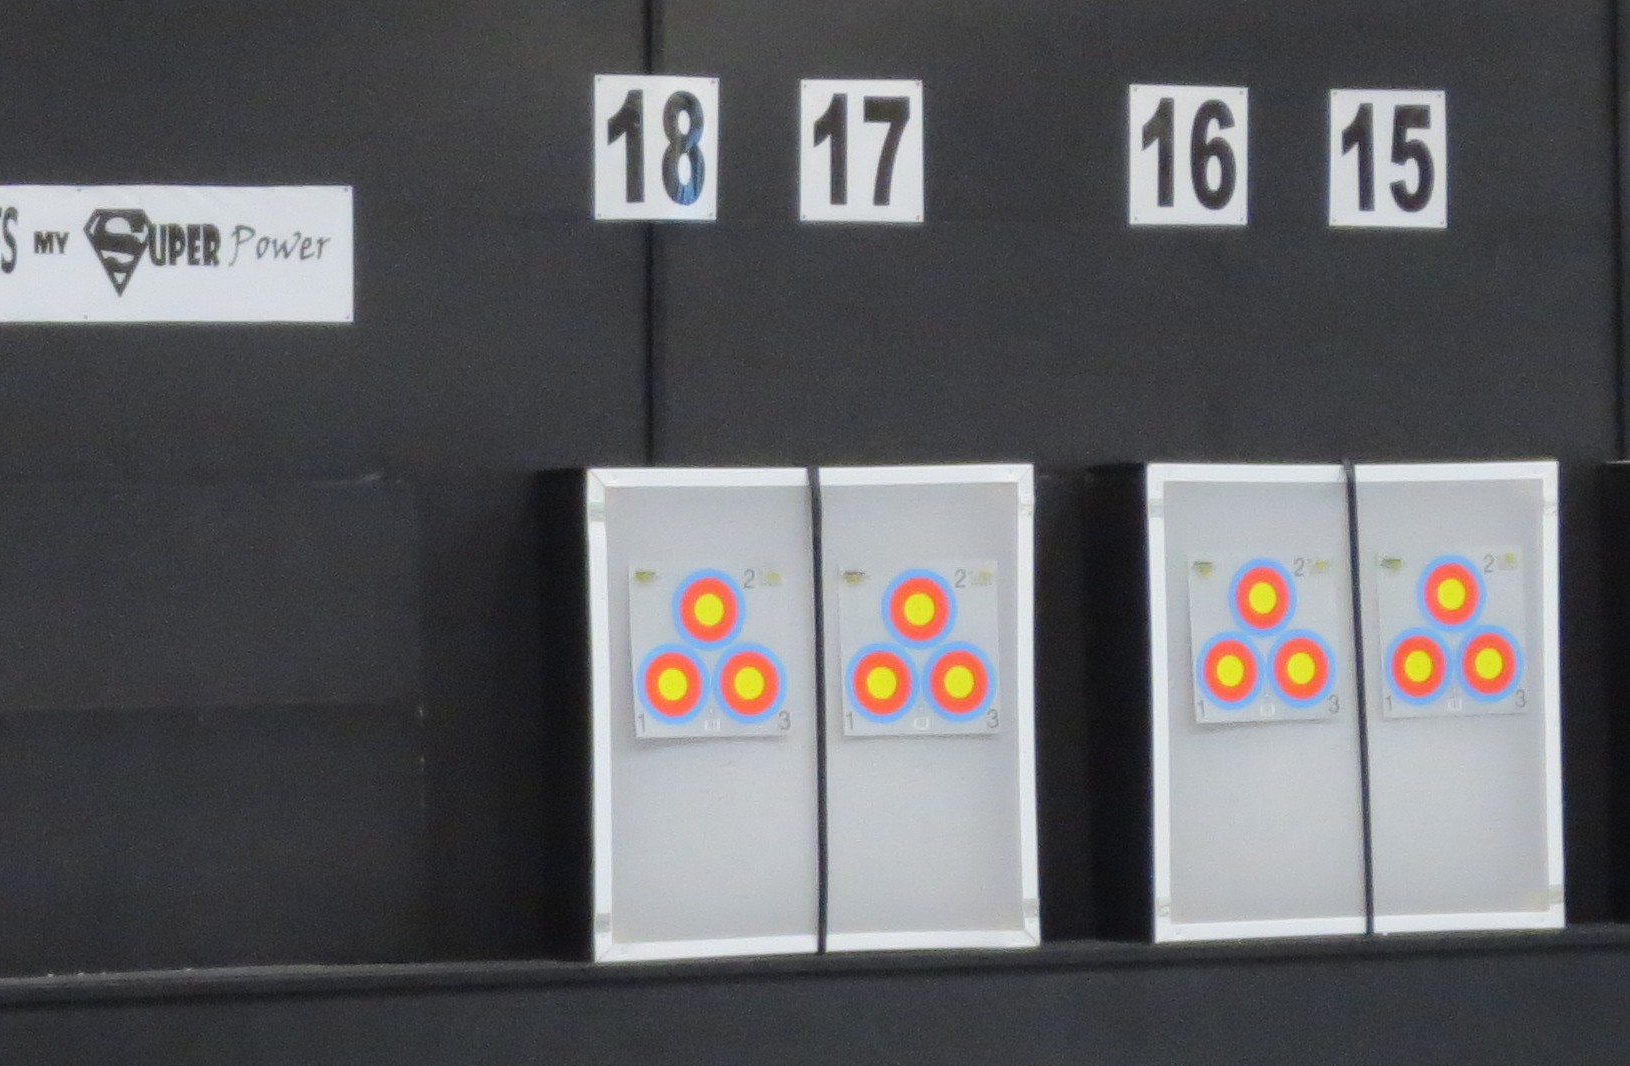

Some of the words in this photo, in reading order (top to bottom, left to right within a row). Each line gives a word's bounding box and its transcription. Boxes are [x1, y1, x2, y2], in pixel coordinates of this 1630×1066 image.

[607, 89, 705, 206] 18
[813, 93, 910, 206] 17
[1142, 97, 1236, 210] 16
[1341, 102, 1435, 212] 15
[34, 231, 69, 254] MY
[229, 224, 332, 266] Power
[1293, 557, 1305, 577] 2
[1483, 554, 1495, 573] 2
[744, 569, 755, 588] 2
[955, 568, 967, 588] 2
[1329, 694, 1340, 714] 3
[1515, 689, 1526, 708] 3
[778, 710, 791, 730] 3
[987, 708, 999, 728] 3
